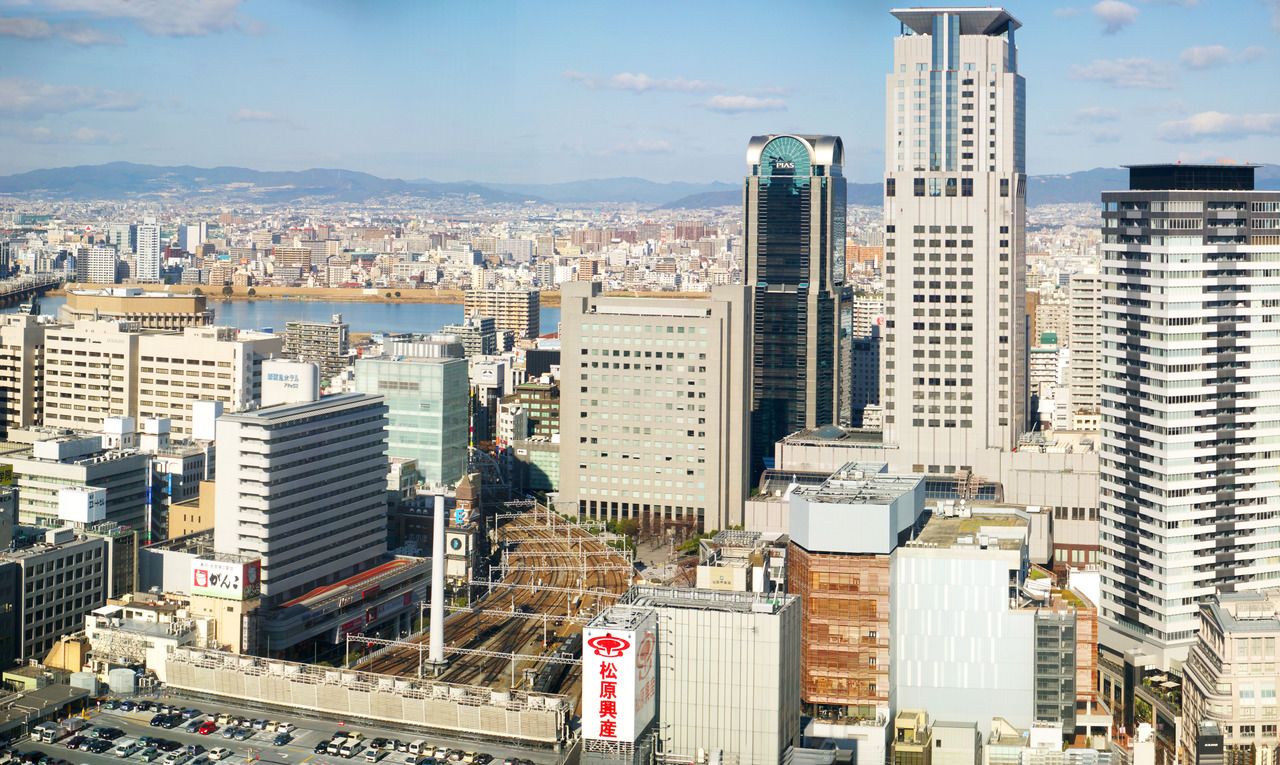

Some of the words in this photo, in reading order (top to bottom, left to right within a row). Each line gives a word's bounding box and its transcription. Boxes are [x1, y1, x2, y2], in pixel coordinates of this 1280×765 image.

[209, 573, 240, 590] がんこ
[598, 660, 618, 739] 松原興産
